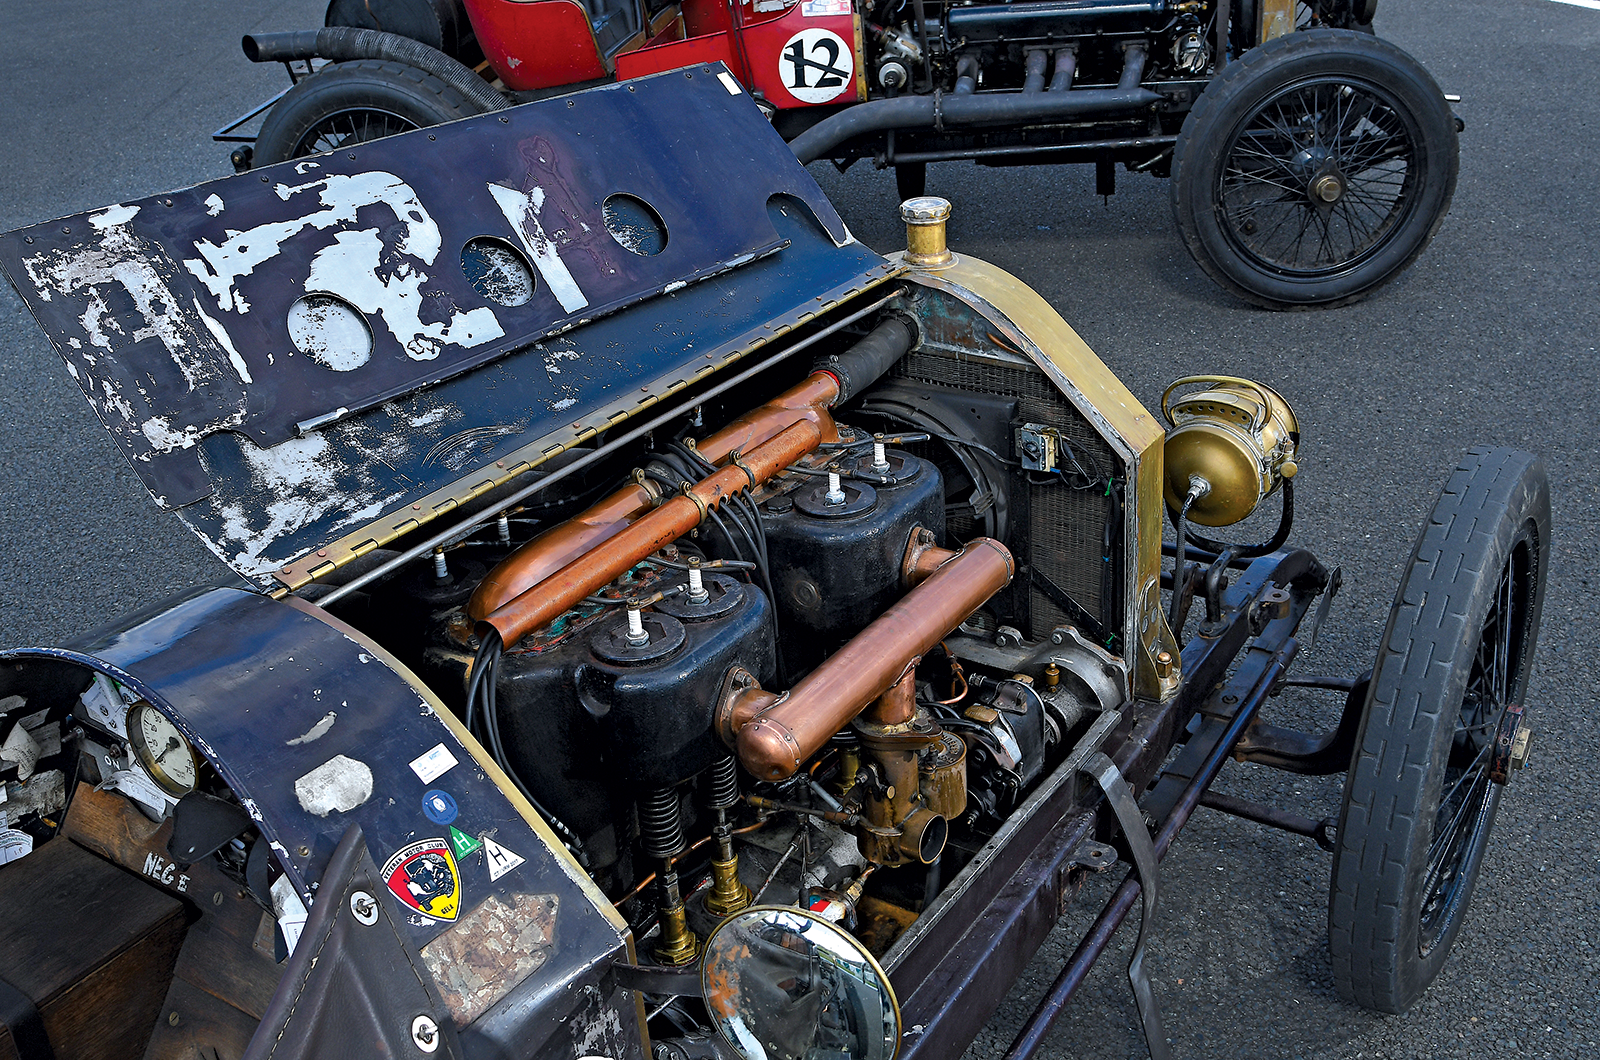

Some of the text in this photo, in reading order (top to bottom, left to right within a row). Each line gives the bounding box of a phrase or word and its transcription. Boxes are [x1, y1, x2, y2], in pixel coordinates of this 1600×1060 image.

[784, 38, 843, 88] 12
[104, 755, 121, 771] ON
[452, 832, 471, 850] H
[383, 857, 403, 880] VETERAN
[404, 845, 425, 857] MOTOR
[488, 845, 508, 866] H
[142, 850, 176, 885] NEG
[440, 903, 455, 915] GELA
